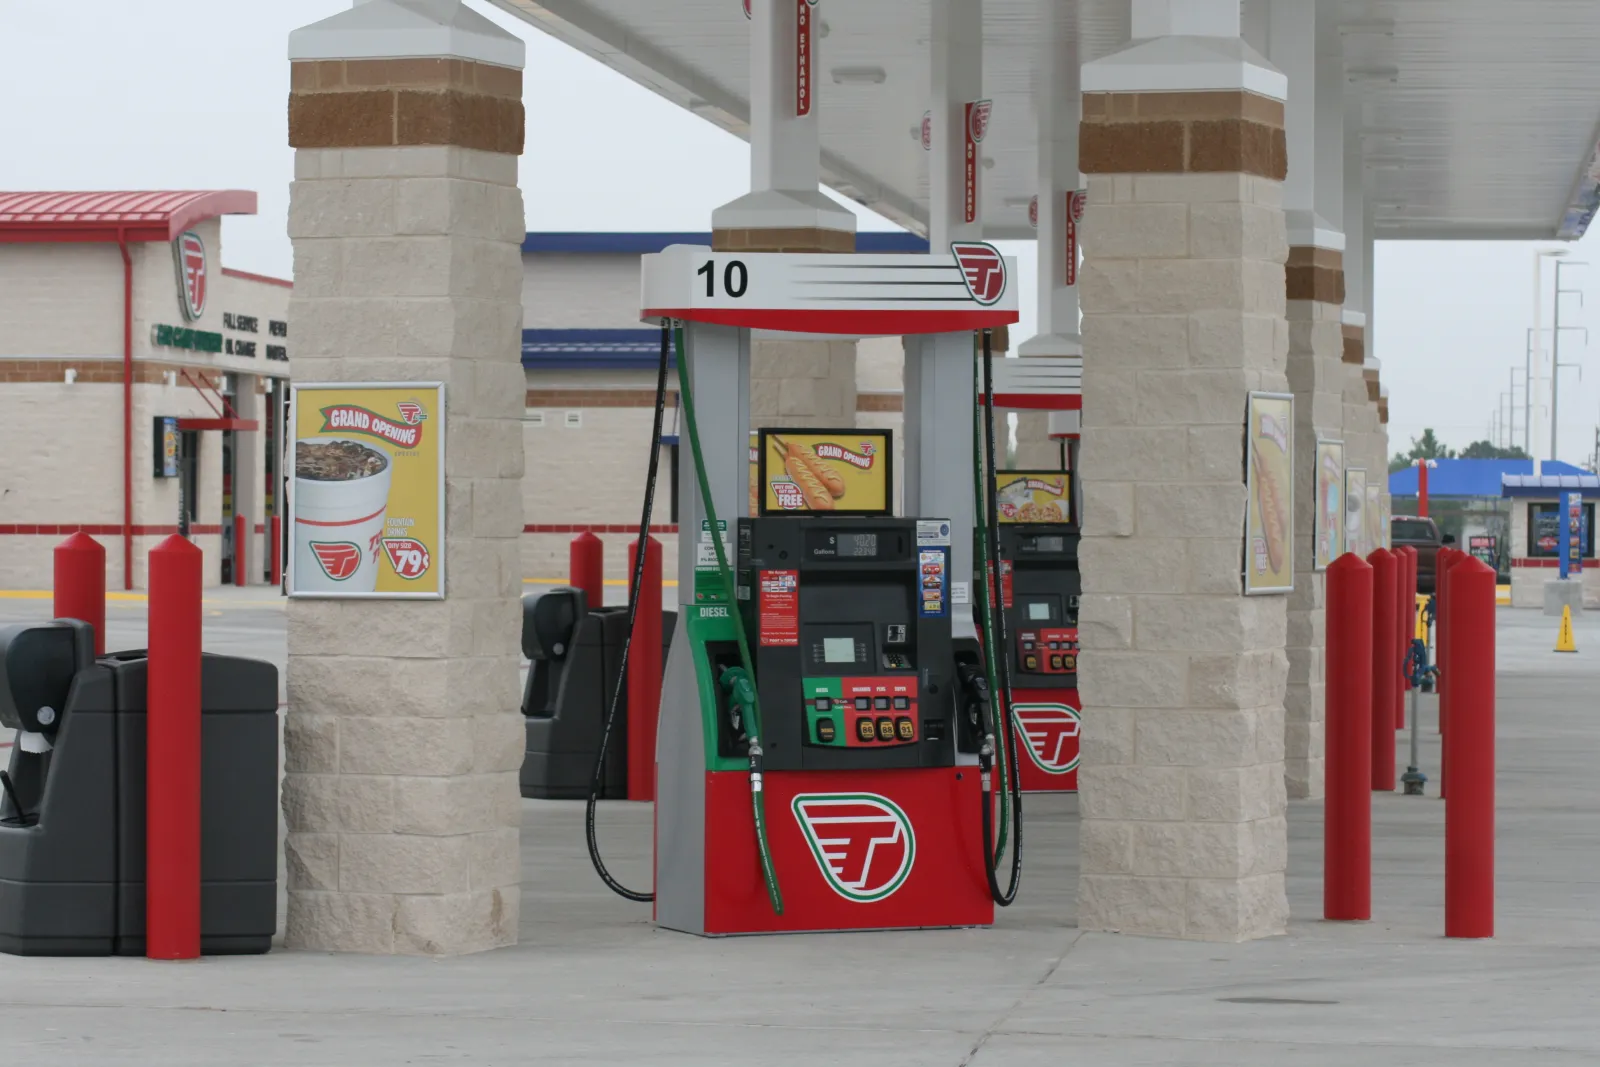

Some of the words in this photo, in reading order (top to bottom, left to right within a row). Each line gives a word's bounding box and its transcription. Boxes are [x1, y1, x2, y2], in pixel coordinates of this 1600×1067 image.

[800, 4, 806, 26] NO
[696, 259, 749, 298] 10
[330, 409, 370, 429] GRAND
[372, 418, 417, 445] OPENING
[818, 445, 843, 458] GRAND
[843, 451, 870, 468] OPENING
[778, 493, 803, 506] FREE
[387, 517, 415, 527] FOUNTAIN
[387, 527, 408, 537] DRINKS
[700, 607, 729, 618] DIESEL
[862, 726, 873, 734] 86
[882, 726, 893, 734] 88
